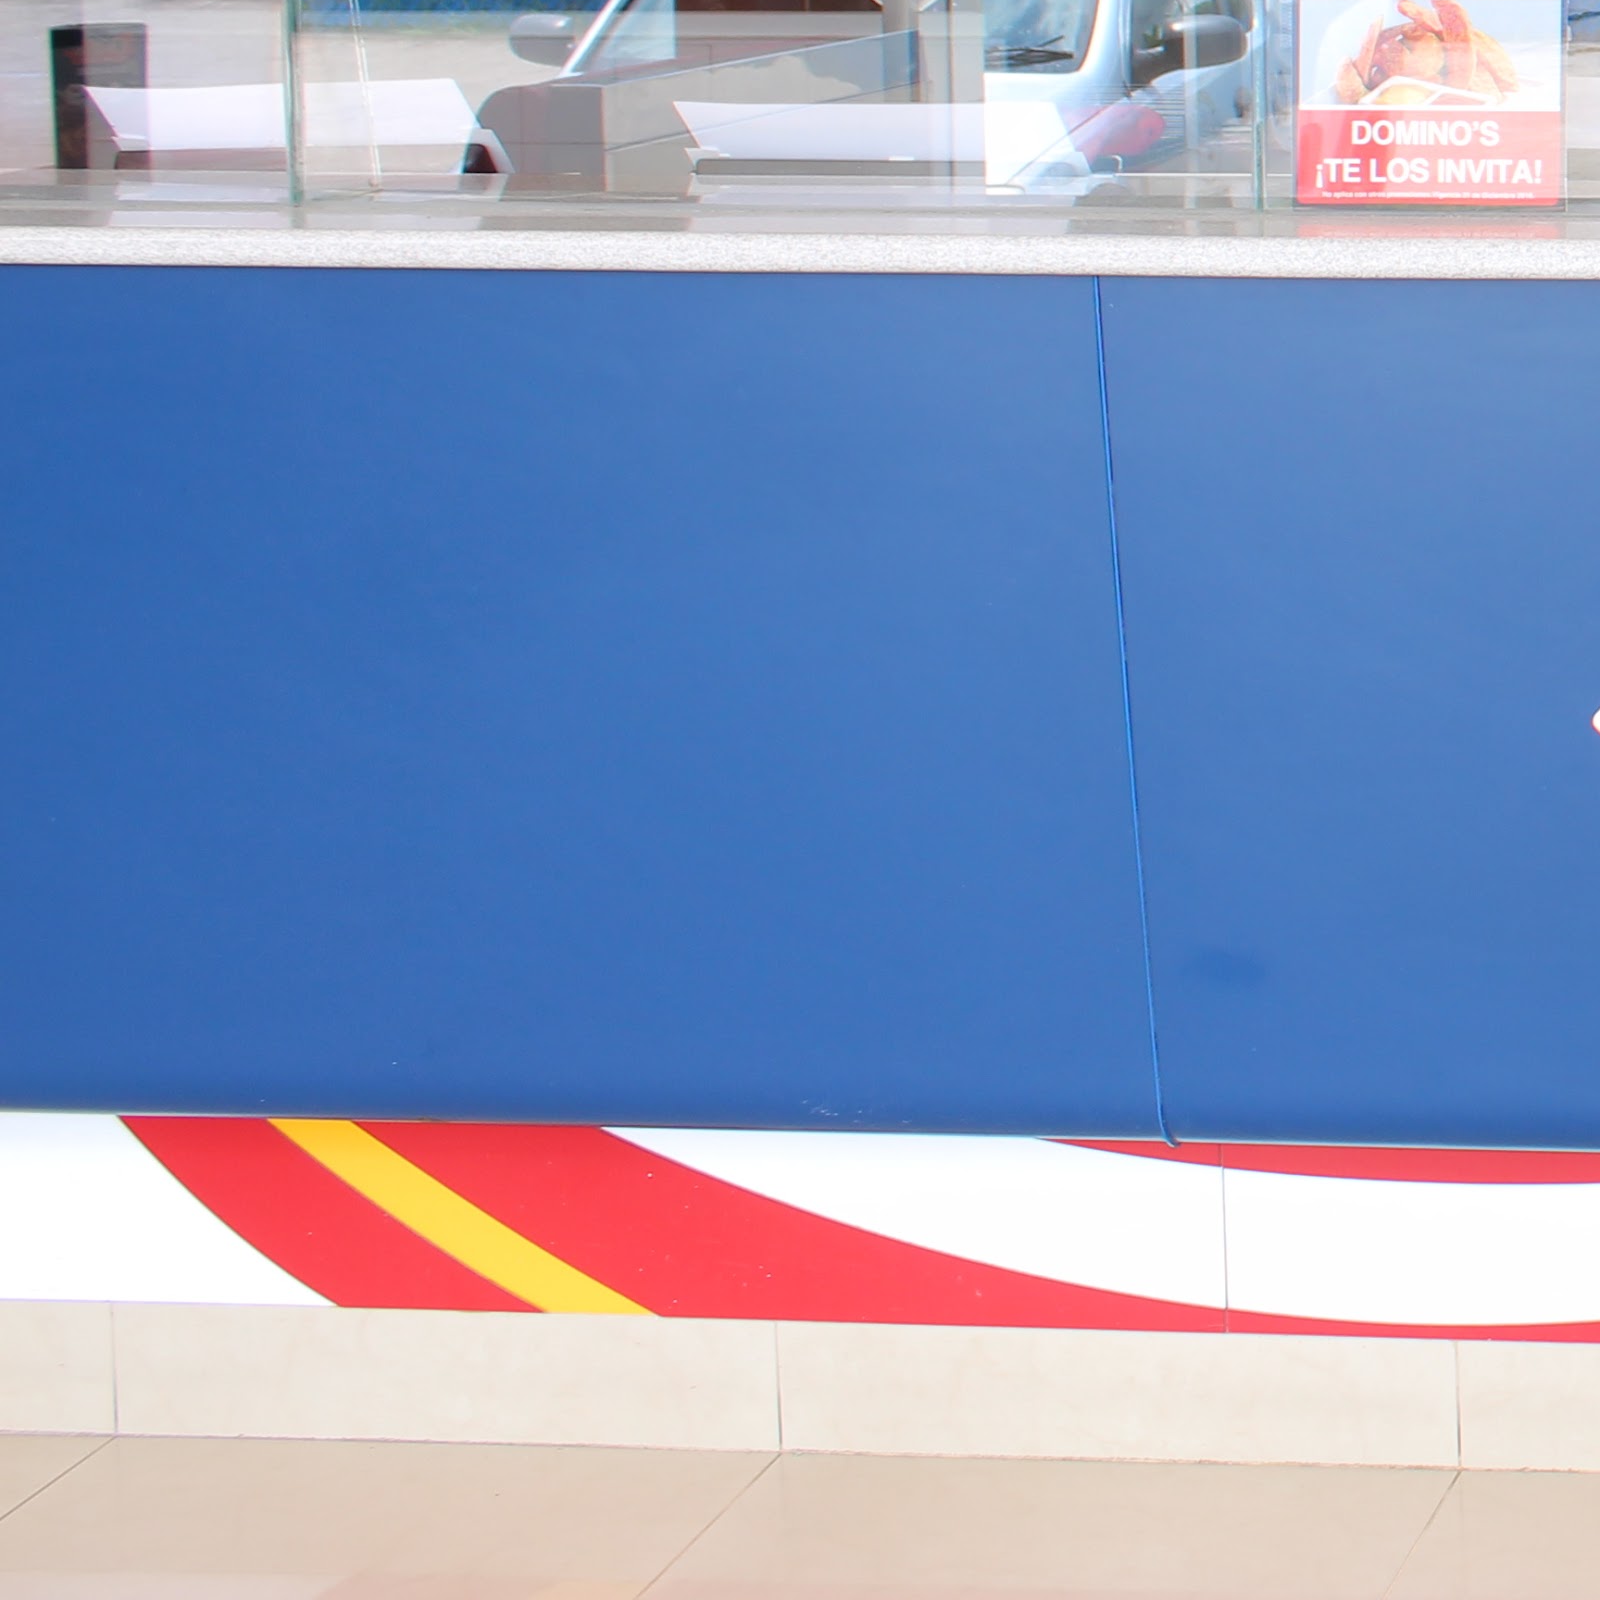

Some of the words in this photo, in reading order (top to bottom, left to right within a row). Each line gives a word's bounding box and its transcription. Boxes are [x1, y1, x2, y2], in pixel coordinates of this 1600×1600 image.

[1350, 119, 1500, 147] DOMINO'S
[1316, 157, 1361, 188] ¡TE
[1369, 157, 1430, 184] LOS
[1437, 158, 1543, 185] INVITA!
